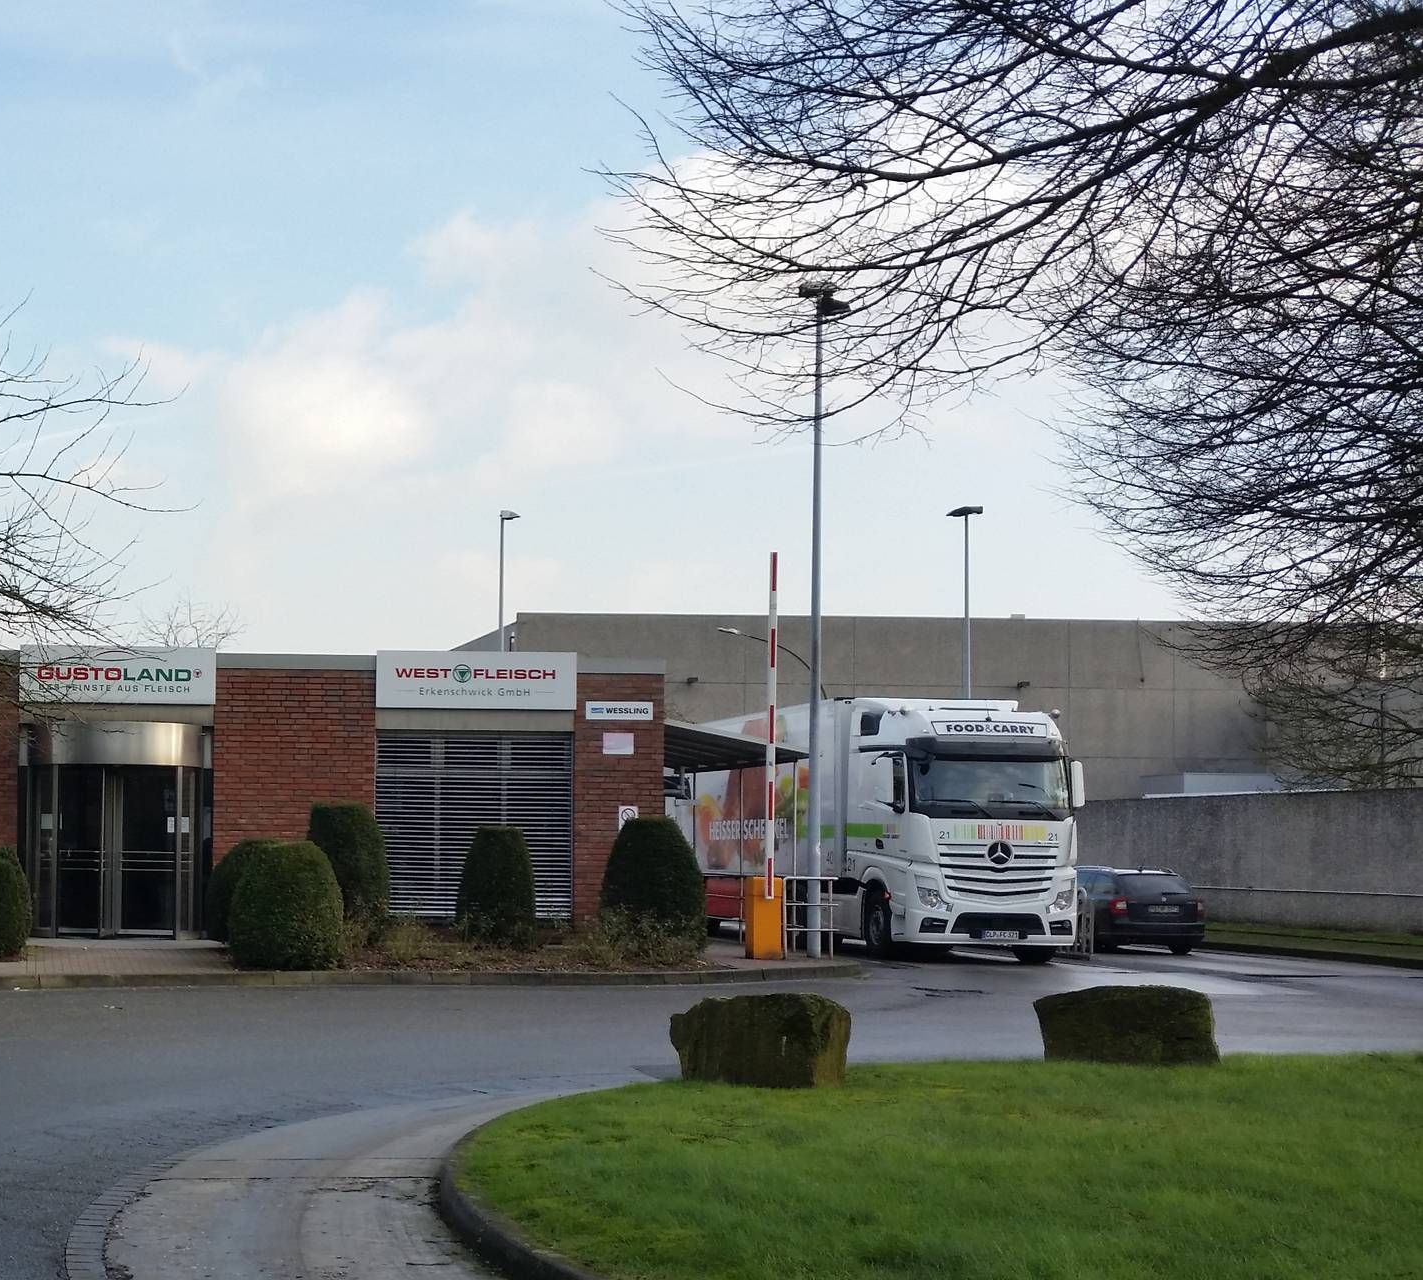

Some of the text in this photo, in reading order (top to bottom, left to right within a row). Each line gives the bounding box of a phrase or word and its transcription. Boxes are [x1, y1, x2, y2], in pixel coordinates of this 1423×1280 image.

[37, 666, 192, 682] GUSTOLAND
[395, 668, 556, 680] WEST FLEISCH
[117, 684, 139, 693] AUS
[144, 684, 191, 693] FLEISCH
[419, 686, 531, 697] Erkenschwick GmbH
[605, 707, 649, 715] WESSLING
[709, 817, 789, 841] HEISSER SCHEKEL
[939, 830, 950, 840] 21
[1048, 832, 1058, 841] 21
